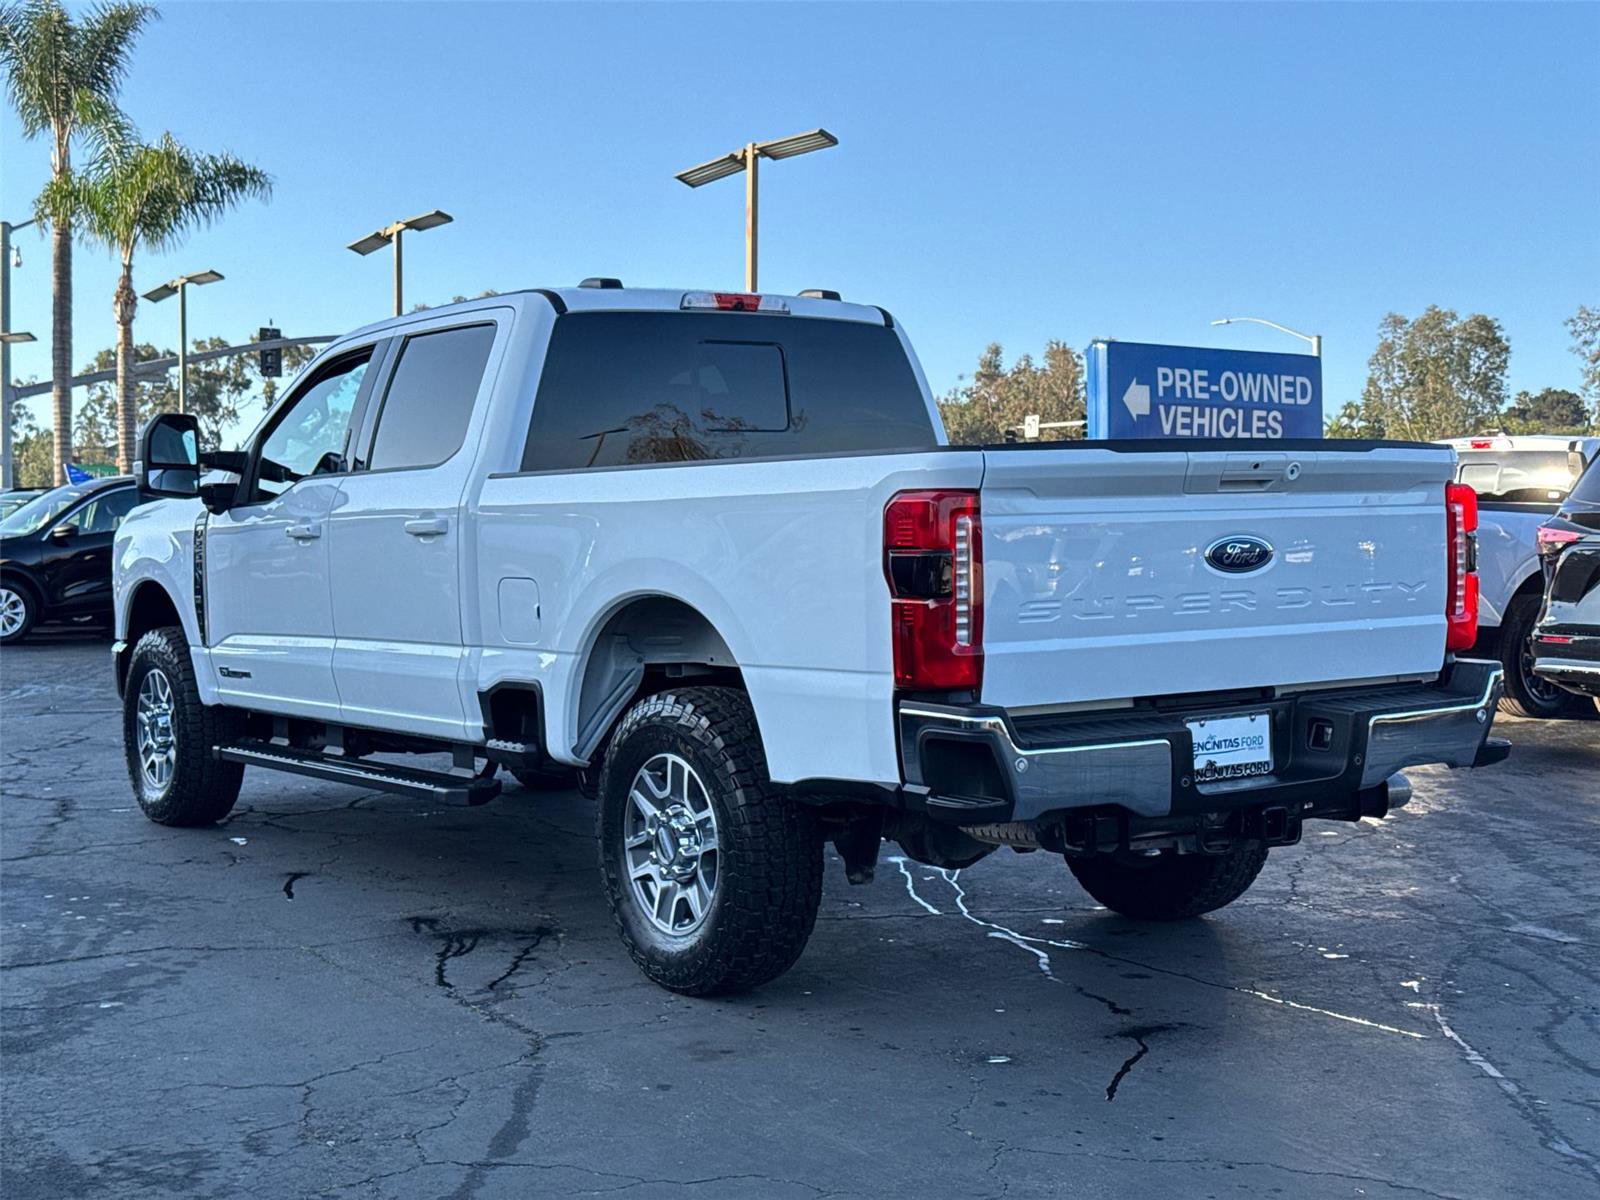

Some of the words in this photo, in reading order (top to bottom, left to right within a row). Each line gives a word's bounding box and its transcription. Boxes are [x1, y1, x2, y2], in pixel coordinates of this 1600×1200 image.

[1157, 367, 1312, 405] PRE-OWNED
[1158, 404, 1283, 439] VEHICLES
[1223, 543, 1260, 564] Ford
[1018, 590, 1257, 623] SUPER
[1277, 580, 1427, 609] DUTY
[1241, 735, 1264, 747] FORD
[1194, 763, 1243, 780] NCINITAS
[1244, 761, 1270, 774] FORD
